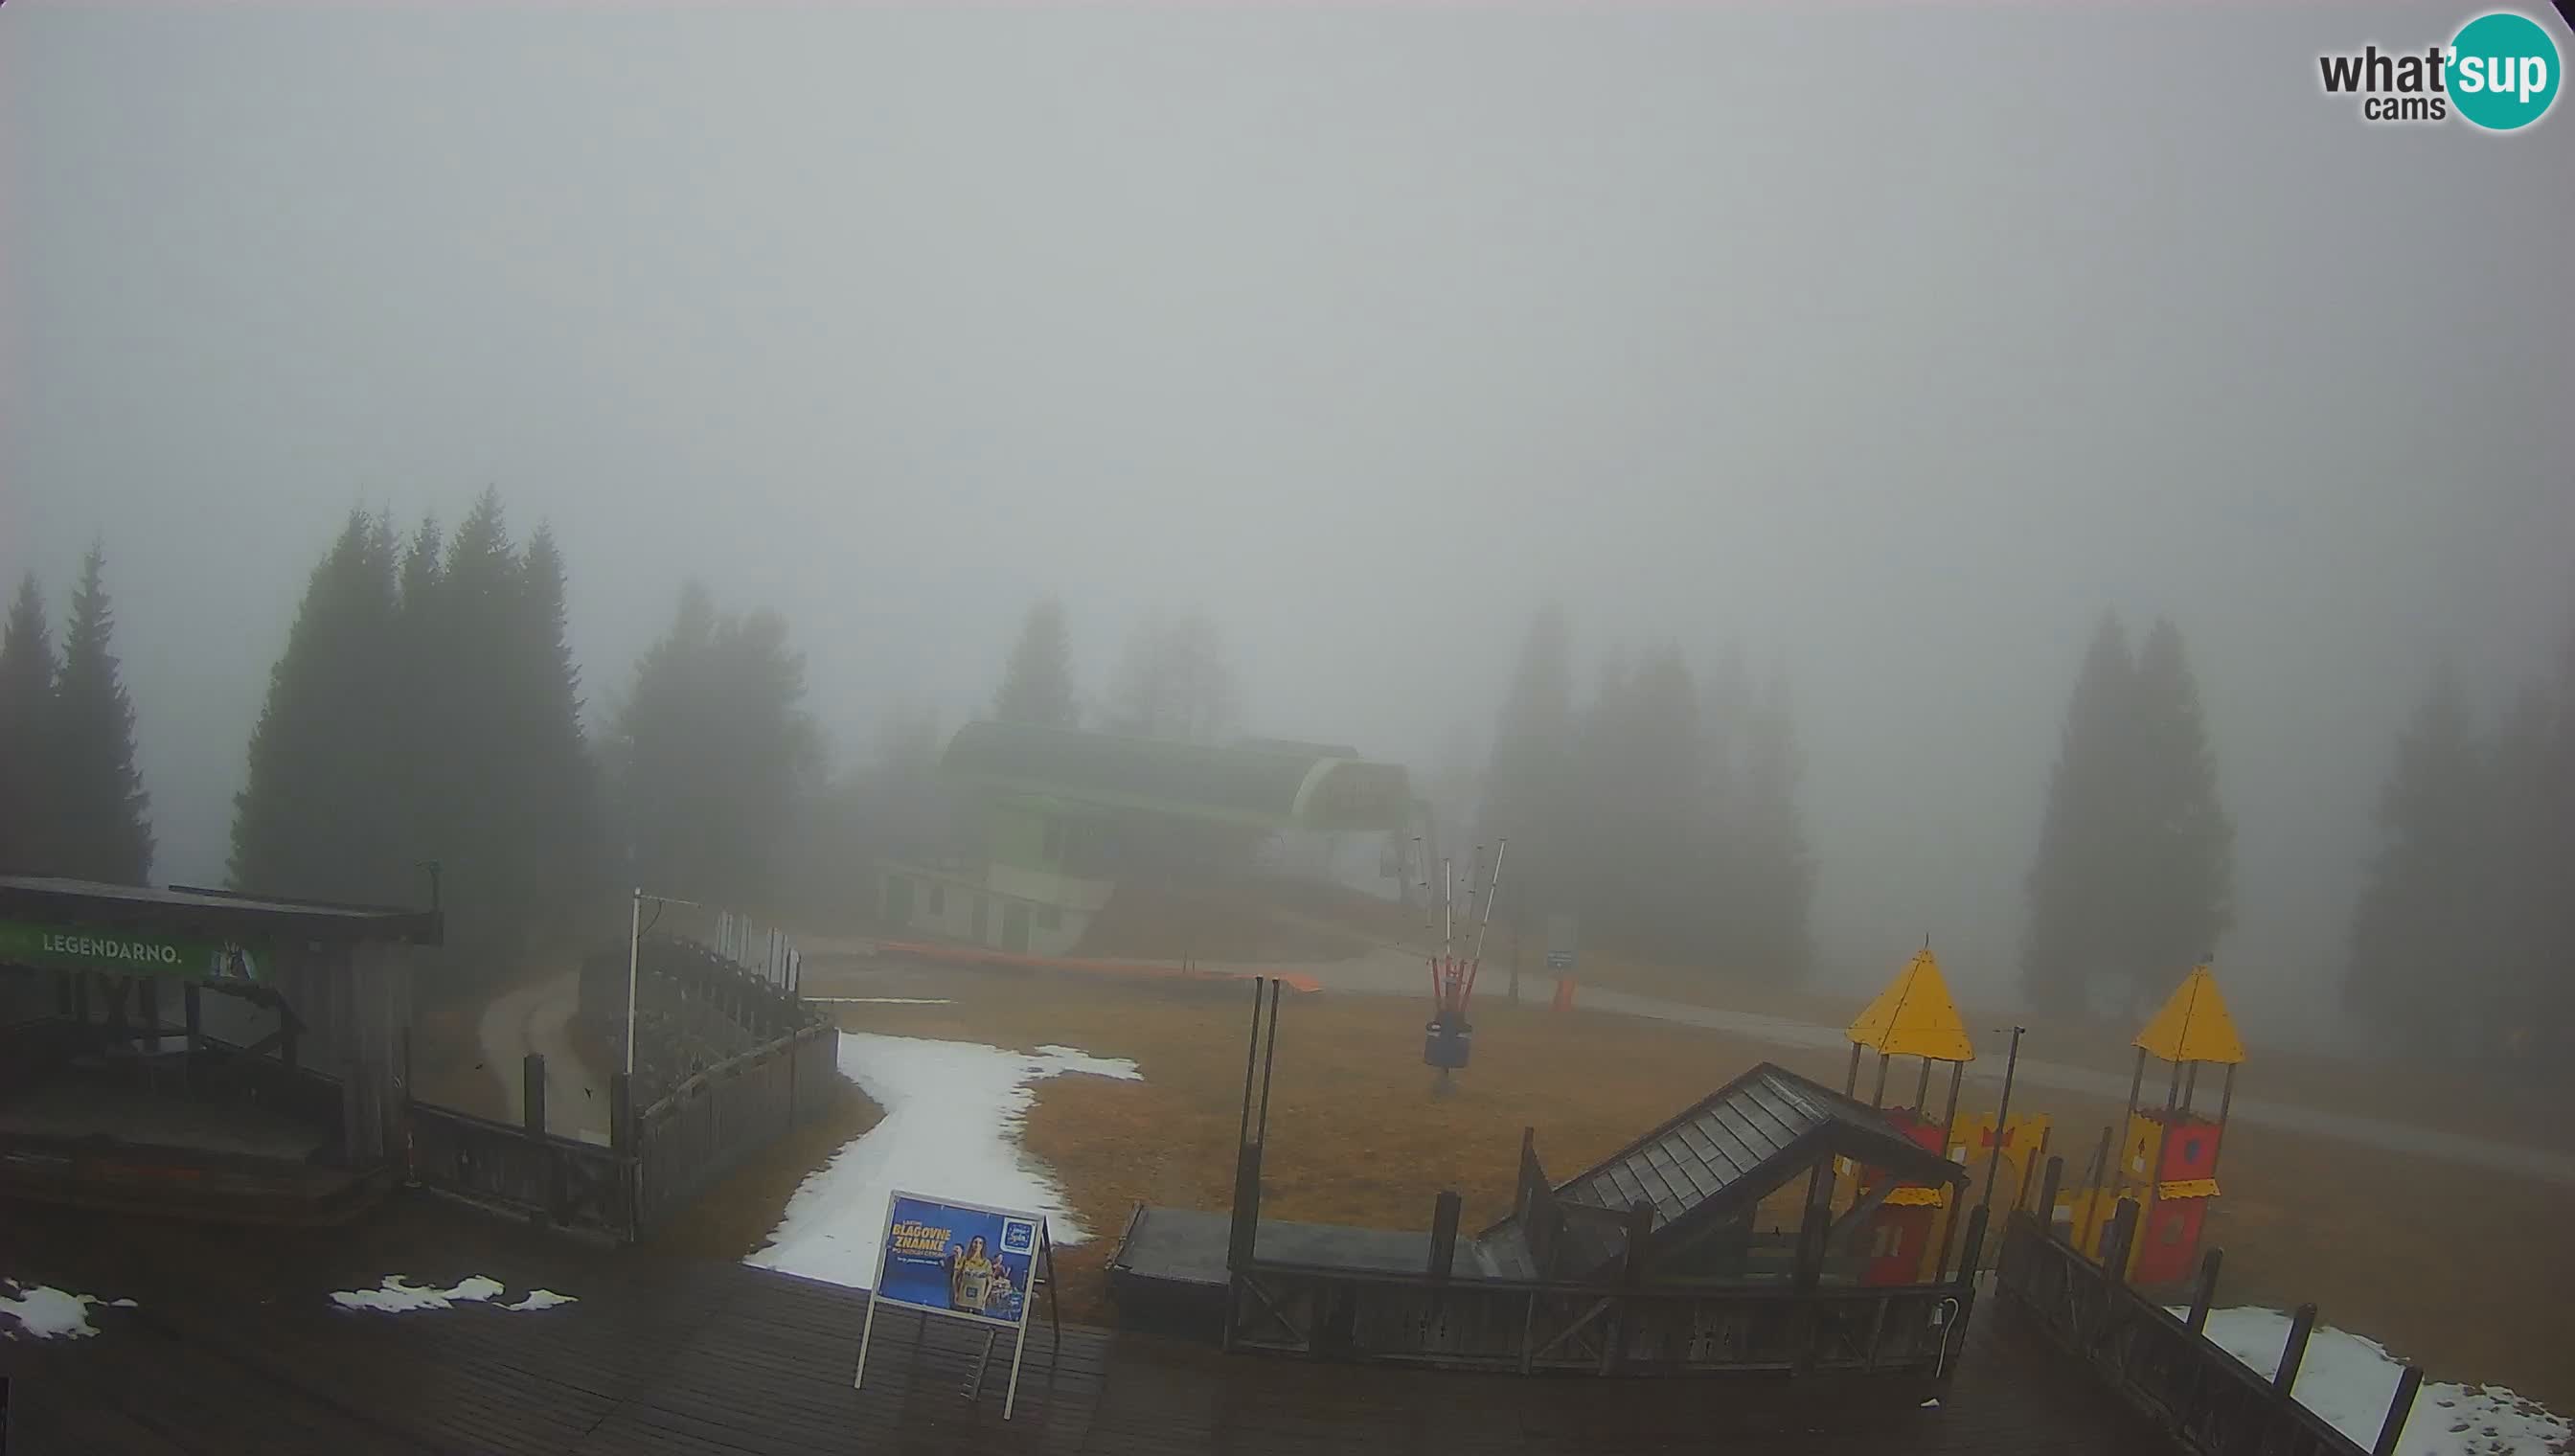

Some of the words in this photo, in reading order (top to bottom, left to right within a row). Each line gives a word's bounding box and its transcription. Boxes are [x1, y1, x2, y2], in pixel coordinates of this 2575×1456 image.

[43, 933, 183, 965] LEGENDARNO.
[892, 1223, 951, 1240] BLAGOVNE
[895, 1236, 946, 1252] ZNAMKE
